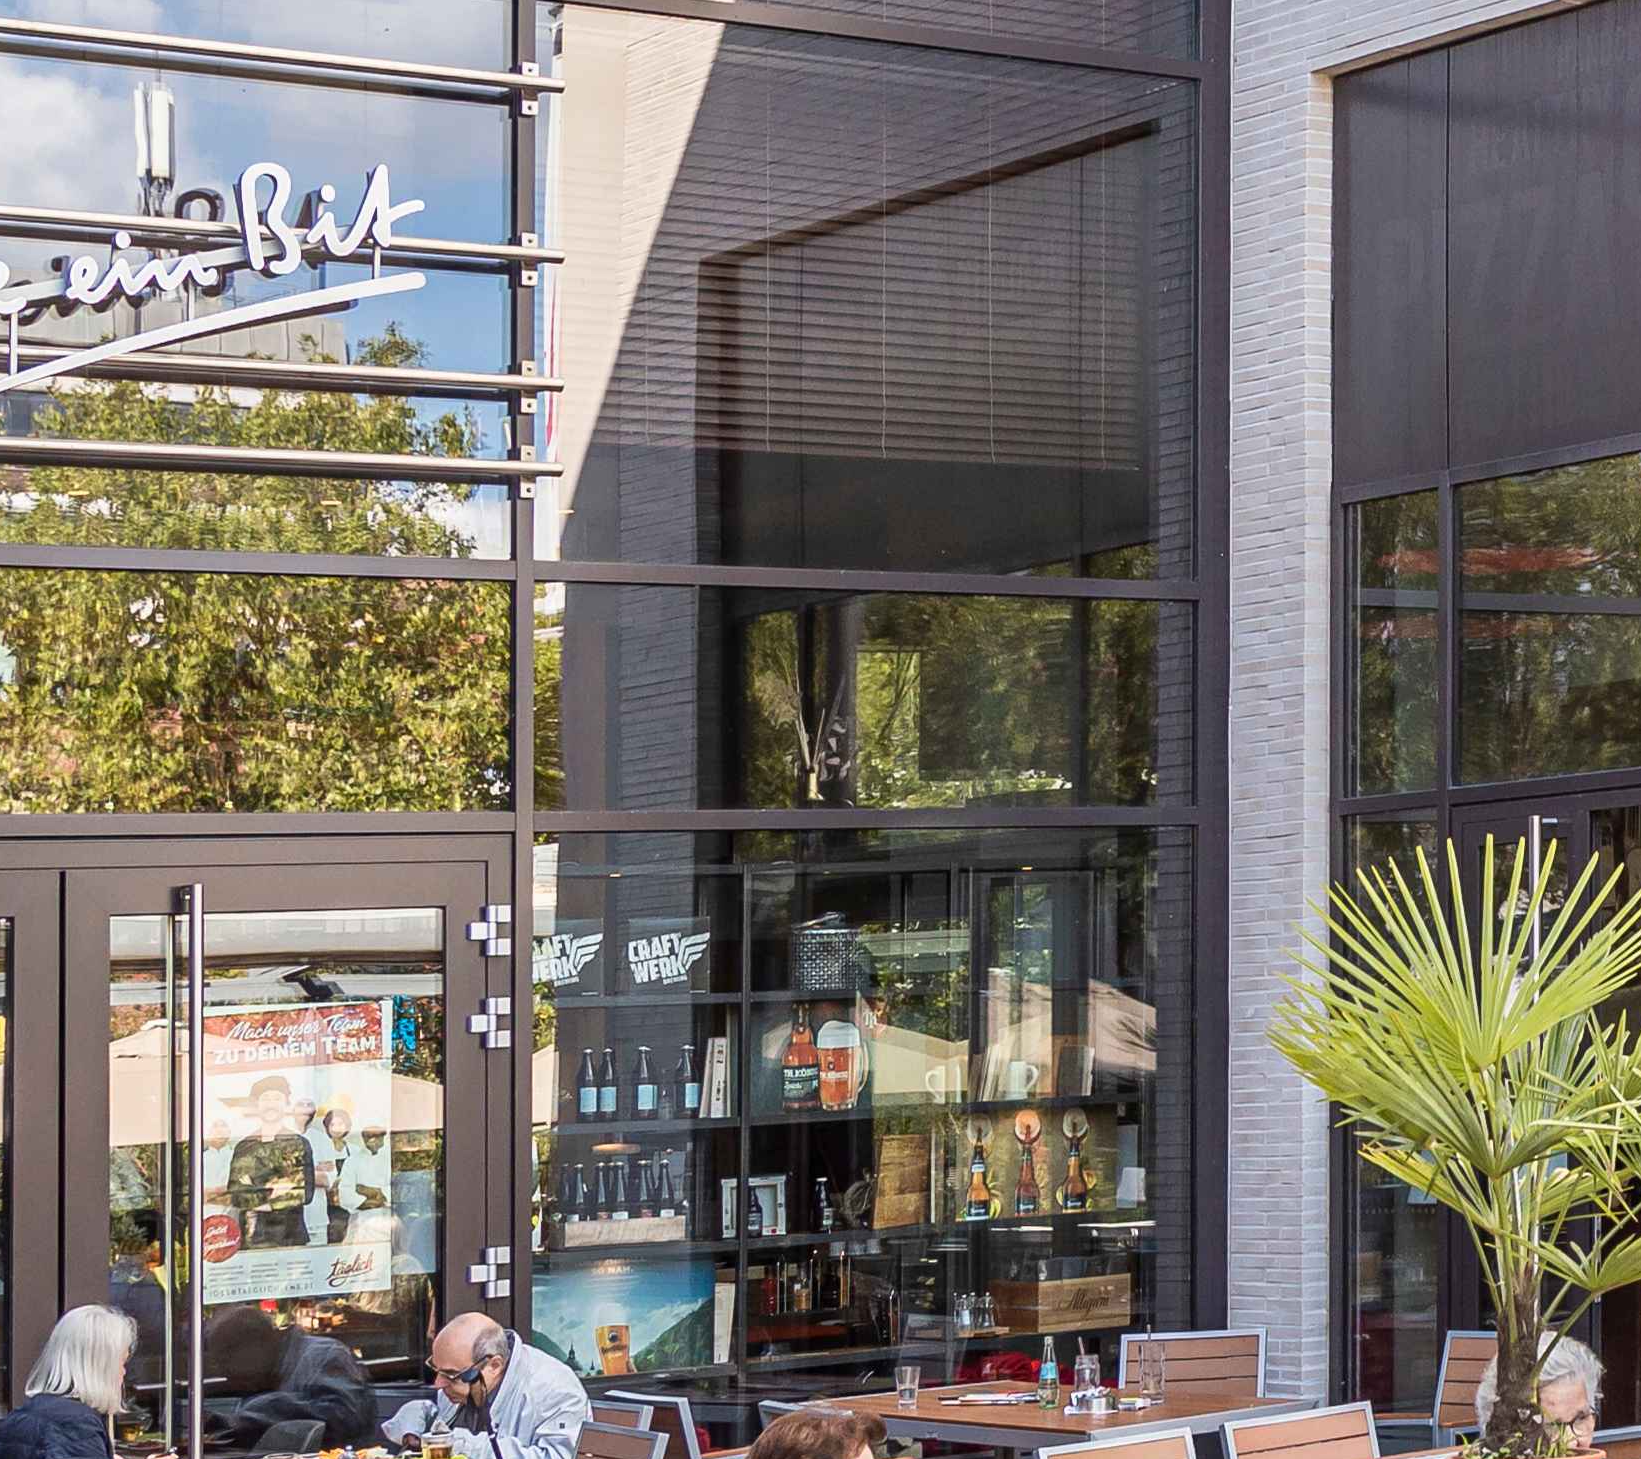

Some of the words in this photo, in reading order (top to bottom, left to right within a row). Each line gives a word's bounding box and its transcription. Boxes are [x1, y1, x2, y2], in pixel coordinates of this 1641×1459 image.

[65, 232, 217, 306] ein
[241, 162, 427, 276] Bit
[627, 932, 682, 962] CRAFT
[629, 955, 687, 984] WERK
[226, 1021, 274, 1042] Mach
[323, 1014, 368, 1033] Team
[214, 1048, 239, 1064] ZU
[243, 1041, 317, 1062] DEINEM
[322, 1036, 376, 1055] TEAM
[327, 1251, 374, 1287] täglich
